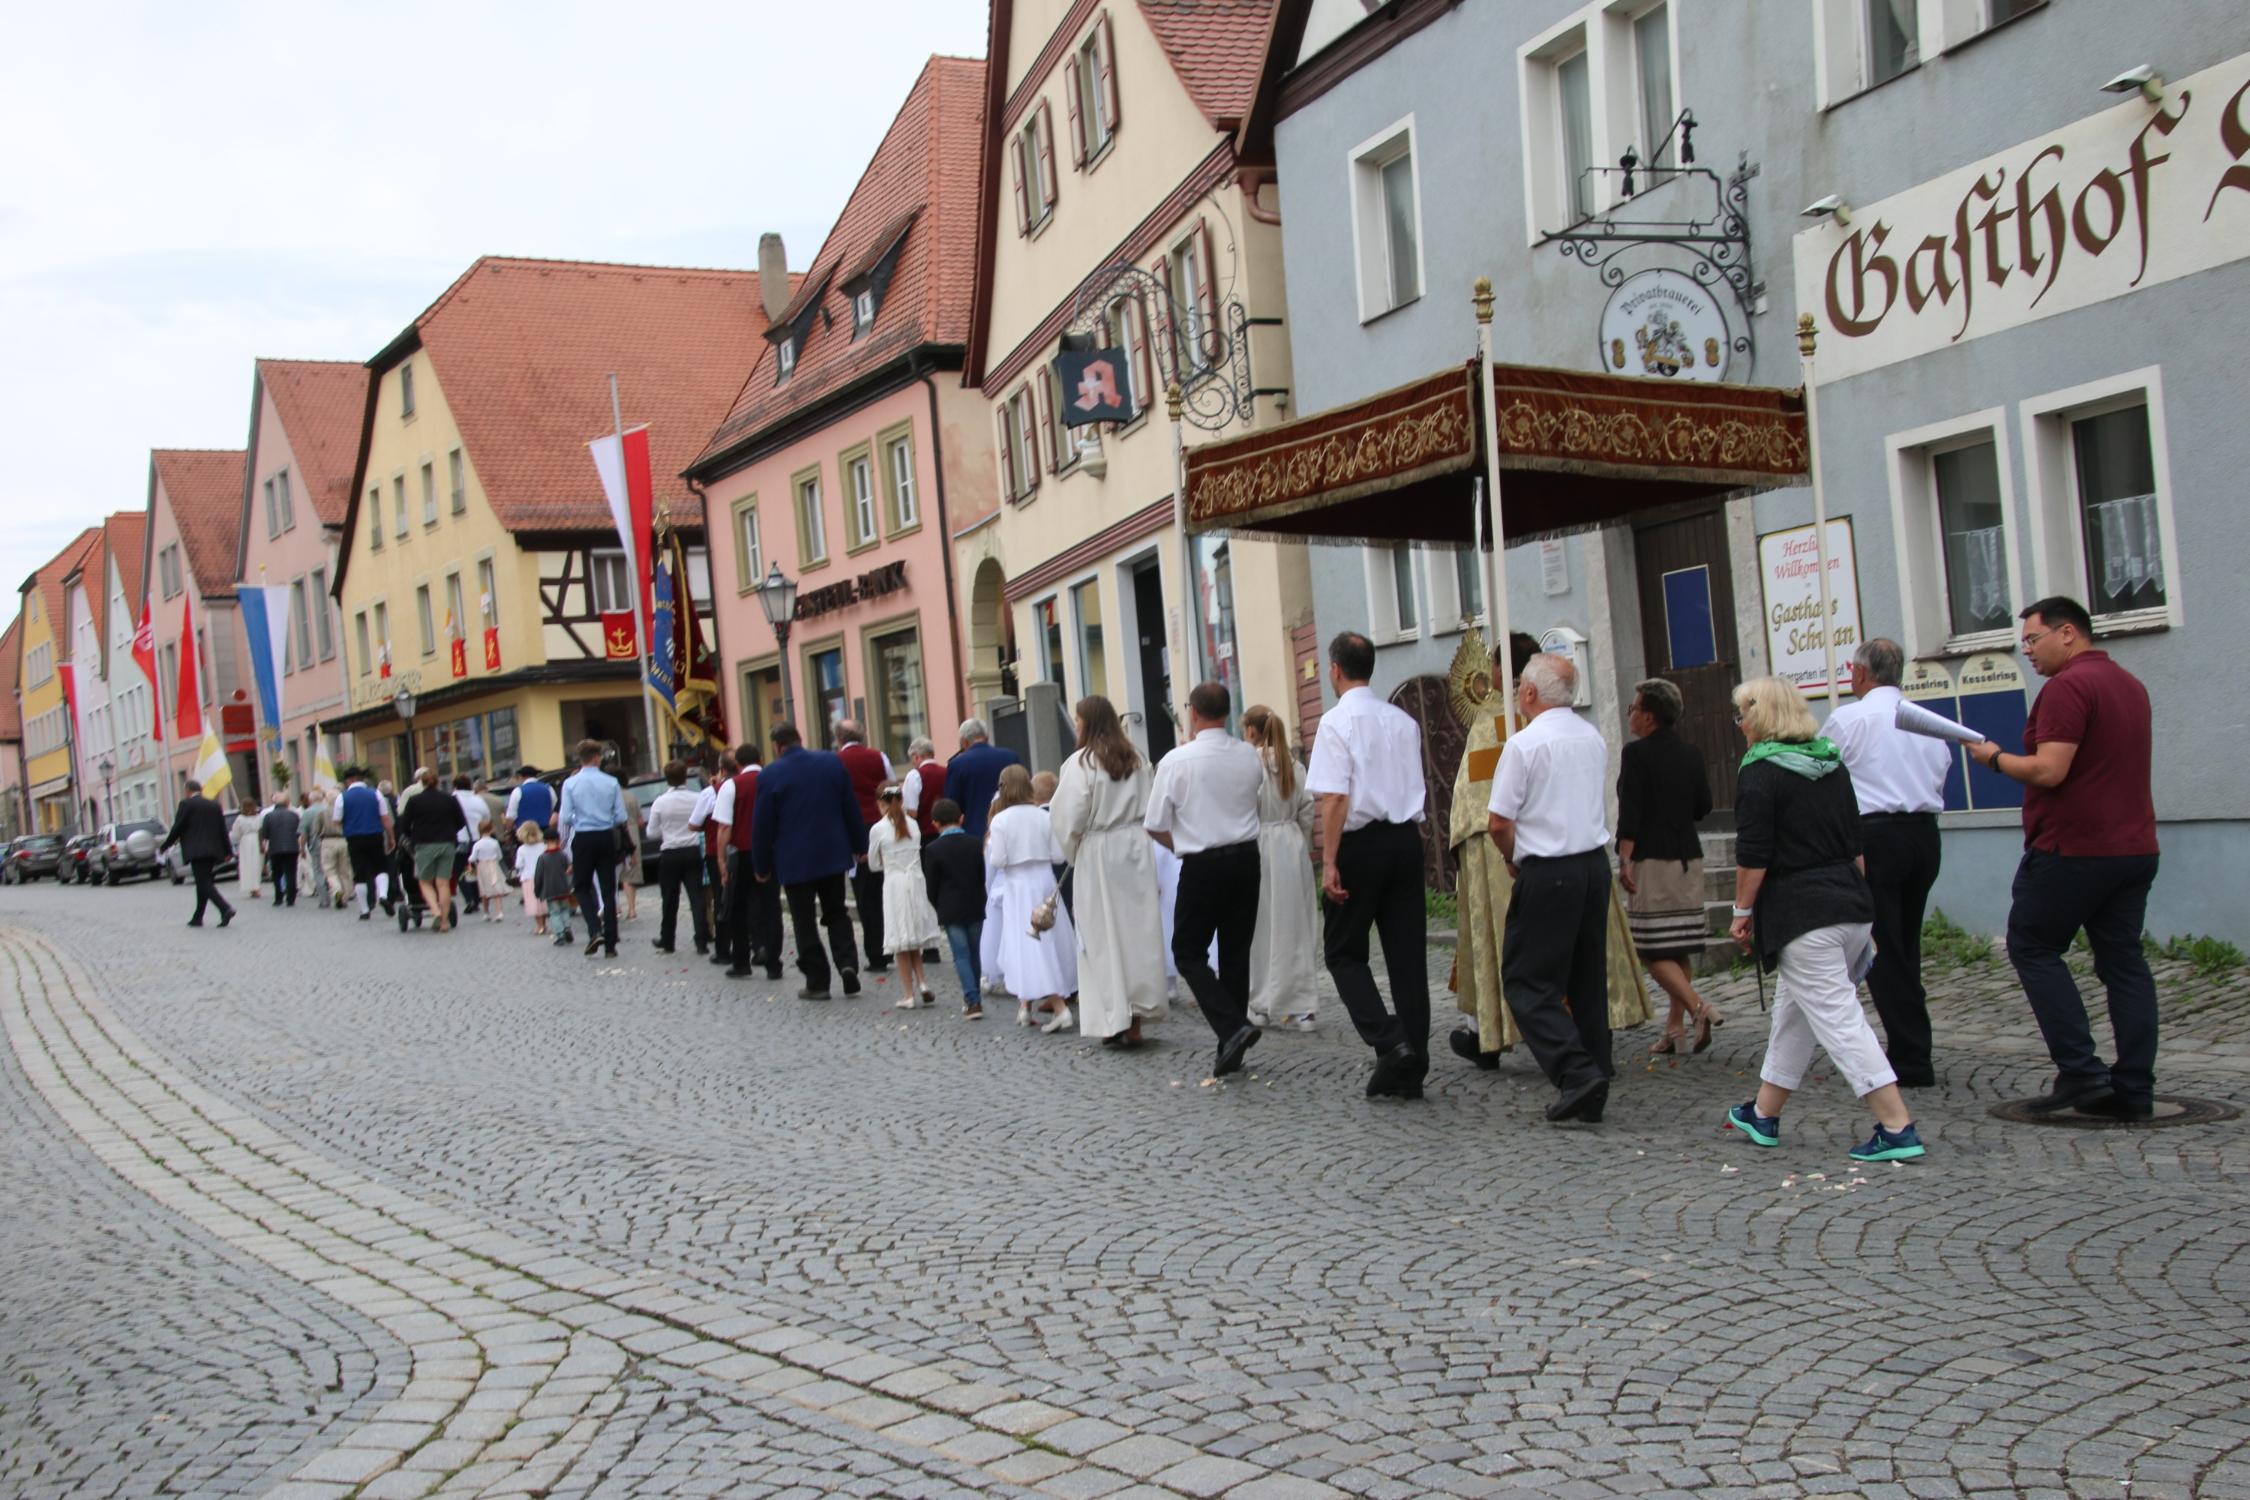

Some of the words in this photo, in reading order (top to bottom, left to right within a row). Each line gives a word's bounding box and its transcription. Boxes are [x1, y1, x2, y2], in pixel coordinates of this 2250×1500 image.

[1825, 89, 2191, 342] Gasthof
[1619, 284, 1704, 316] Privatbrauerei
[1073, 359, 1122, 412] A
[1774, 557, 1840, 579] Willkomen
[1771, 594, 1838, 632] Gasthas
[1962, 671, 2017, 684] Kesselring
